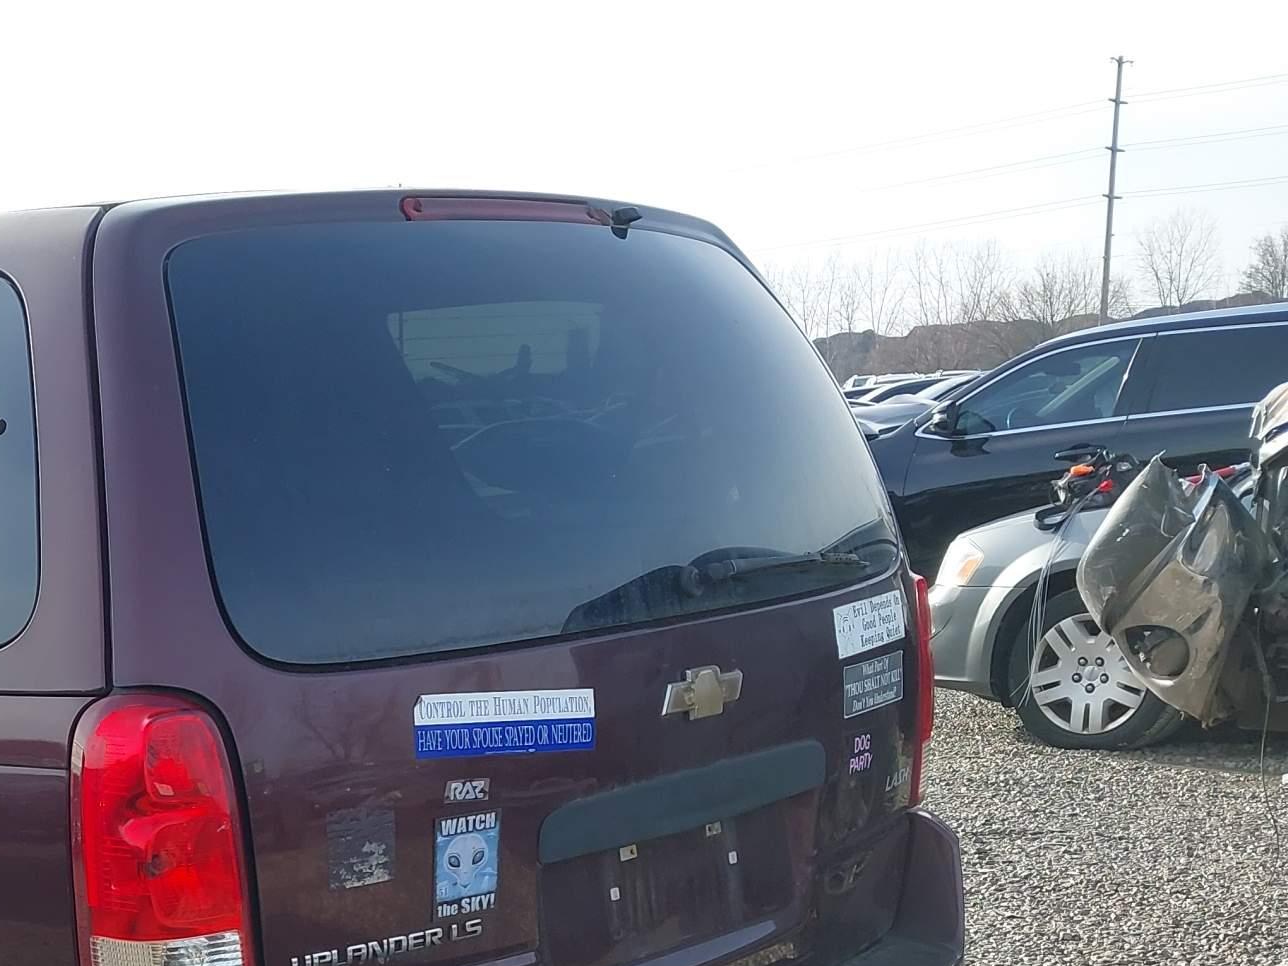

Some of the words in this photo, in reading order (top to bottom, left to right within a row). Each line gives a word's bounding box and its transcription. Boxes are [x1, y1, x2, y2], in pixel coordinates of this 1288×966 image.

[852, 602, 868, 618] Evil
[869, 595, 892, 614] Depends
[862, 615, 877, 631] Good
[878, 609, 897, 627] People
[860, 630, 885, 648] Keeping
[886, 625, 901, 639] Quiet
[864, 676, 880, 692] SHALT
[880, 672, 891, 687] NOT
[418, 699, 466, 720] CONTROL
[469, 700, 489, 717] THE
[493, 696, 529, 716] HUMAN
[417, 730, 443, 751] HAVE
[444, 728, 471, 750] YOUR
[472, 726, 503, 749] SPOUSE
[504, 725, 535, 747] SPAYED
[537, 724, 550, 745] OR
[551, 722, 593, 744] NEUTERED
[854, 734, 871, 753] DOG
[849, 752, 872, 775] PARTY
[450, 780, 485, 800] RAZ
[441, 811, 497, 836] WATCH
[437, 903, 459, 918] the
[460, 892, 496, 915] SKY!
[451, 918, 483, 941] LS
